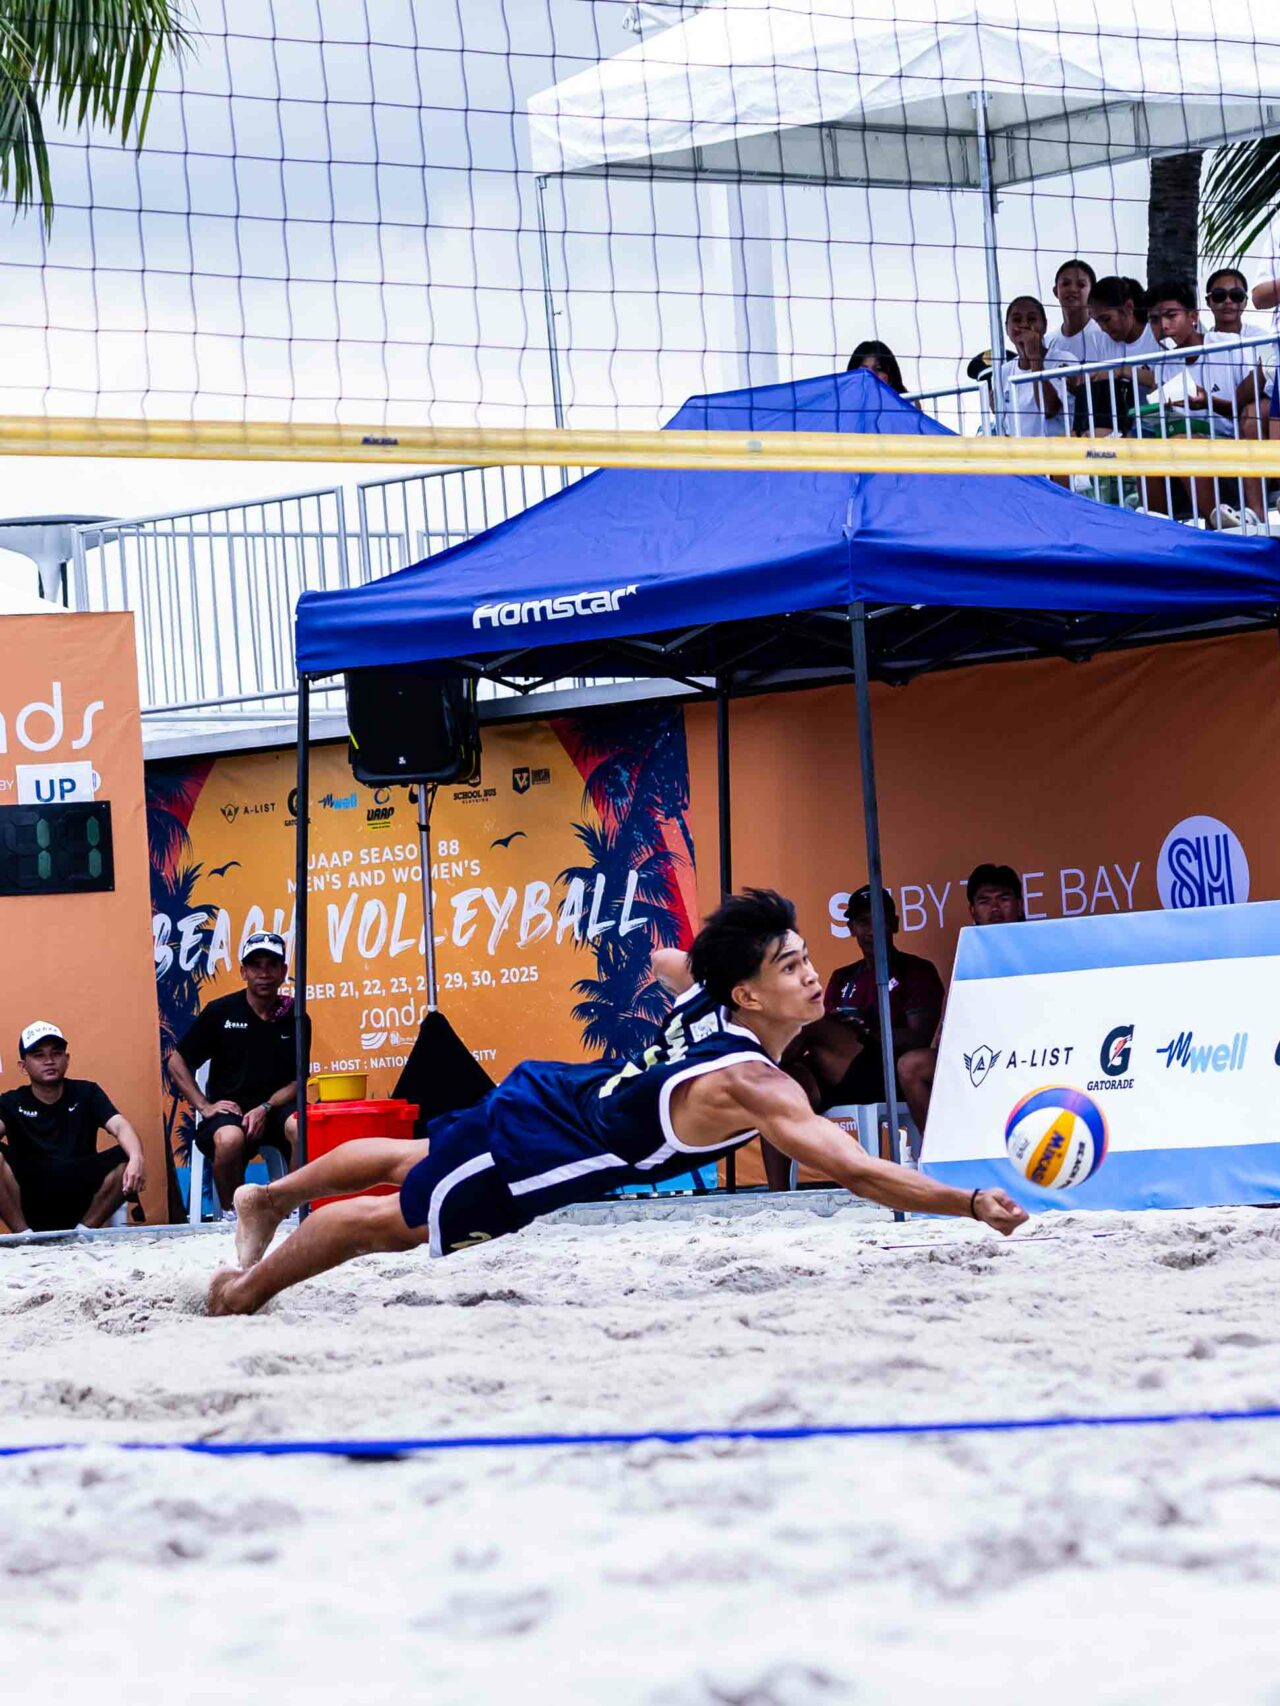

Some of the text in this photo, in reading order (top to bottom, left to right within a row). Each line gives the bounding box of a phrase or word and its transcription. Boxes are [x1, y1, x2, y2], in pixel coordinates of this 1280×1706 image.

[472, 584, 641, 630] Homstar
[35, 777, 77, 803] UP
[243, 802, 276, 816] A-LIST
[360, 843, 418, 865] SEASO
[438, 840, 461, 857] 88
[348, 869, 386, 888] AND
[902, 882, 950, 933] BY
[1059, 861, 1141, 917] BAY
[340, 982, 358, 999] 21,
[363, 979, 386, 998] 22,
[391, 977, 414, 995] 23,
[417, 974, 440, 993] 2,
[444, 972, 468, 991] 29,
[471, 970, 496, 988] 30,
[500, 965, 539, 985] 2025
[360, 998, 427, 1030] sands
[331, 1059, 361, 1072] HOST
[1006, 1046, 1074, 1069] A-LIST
[1086, 1078, 1135, 1092] GATORADE
